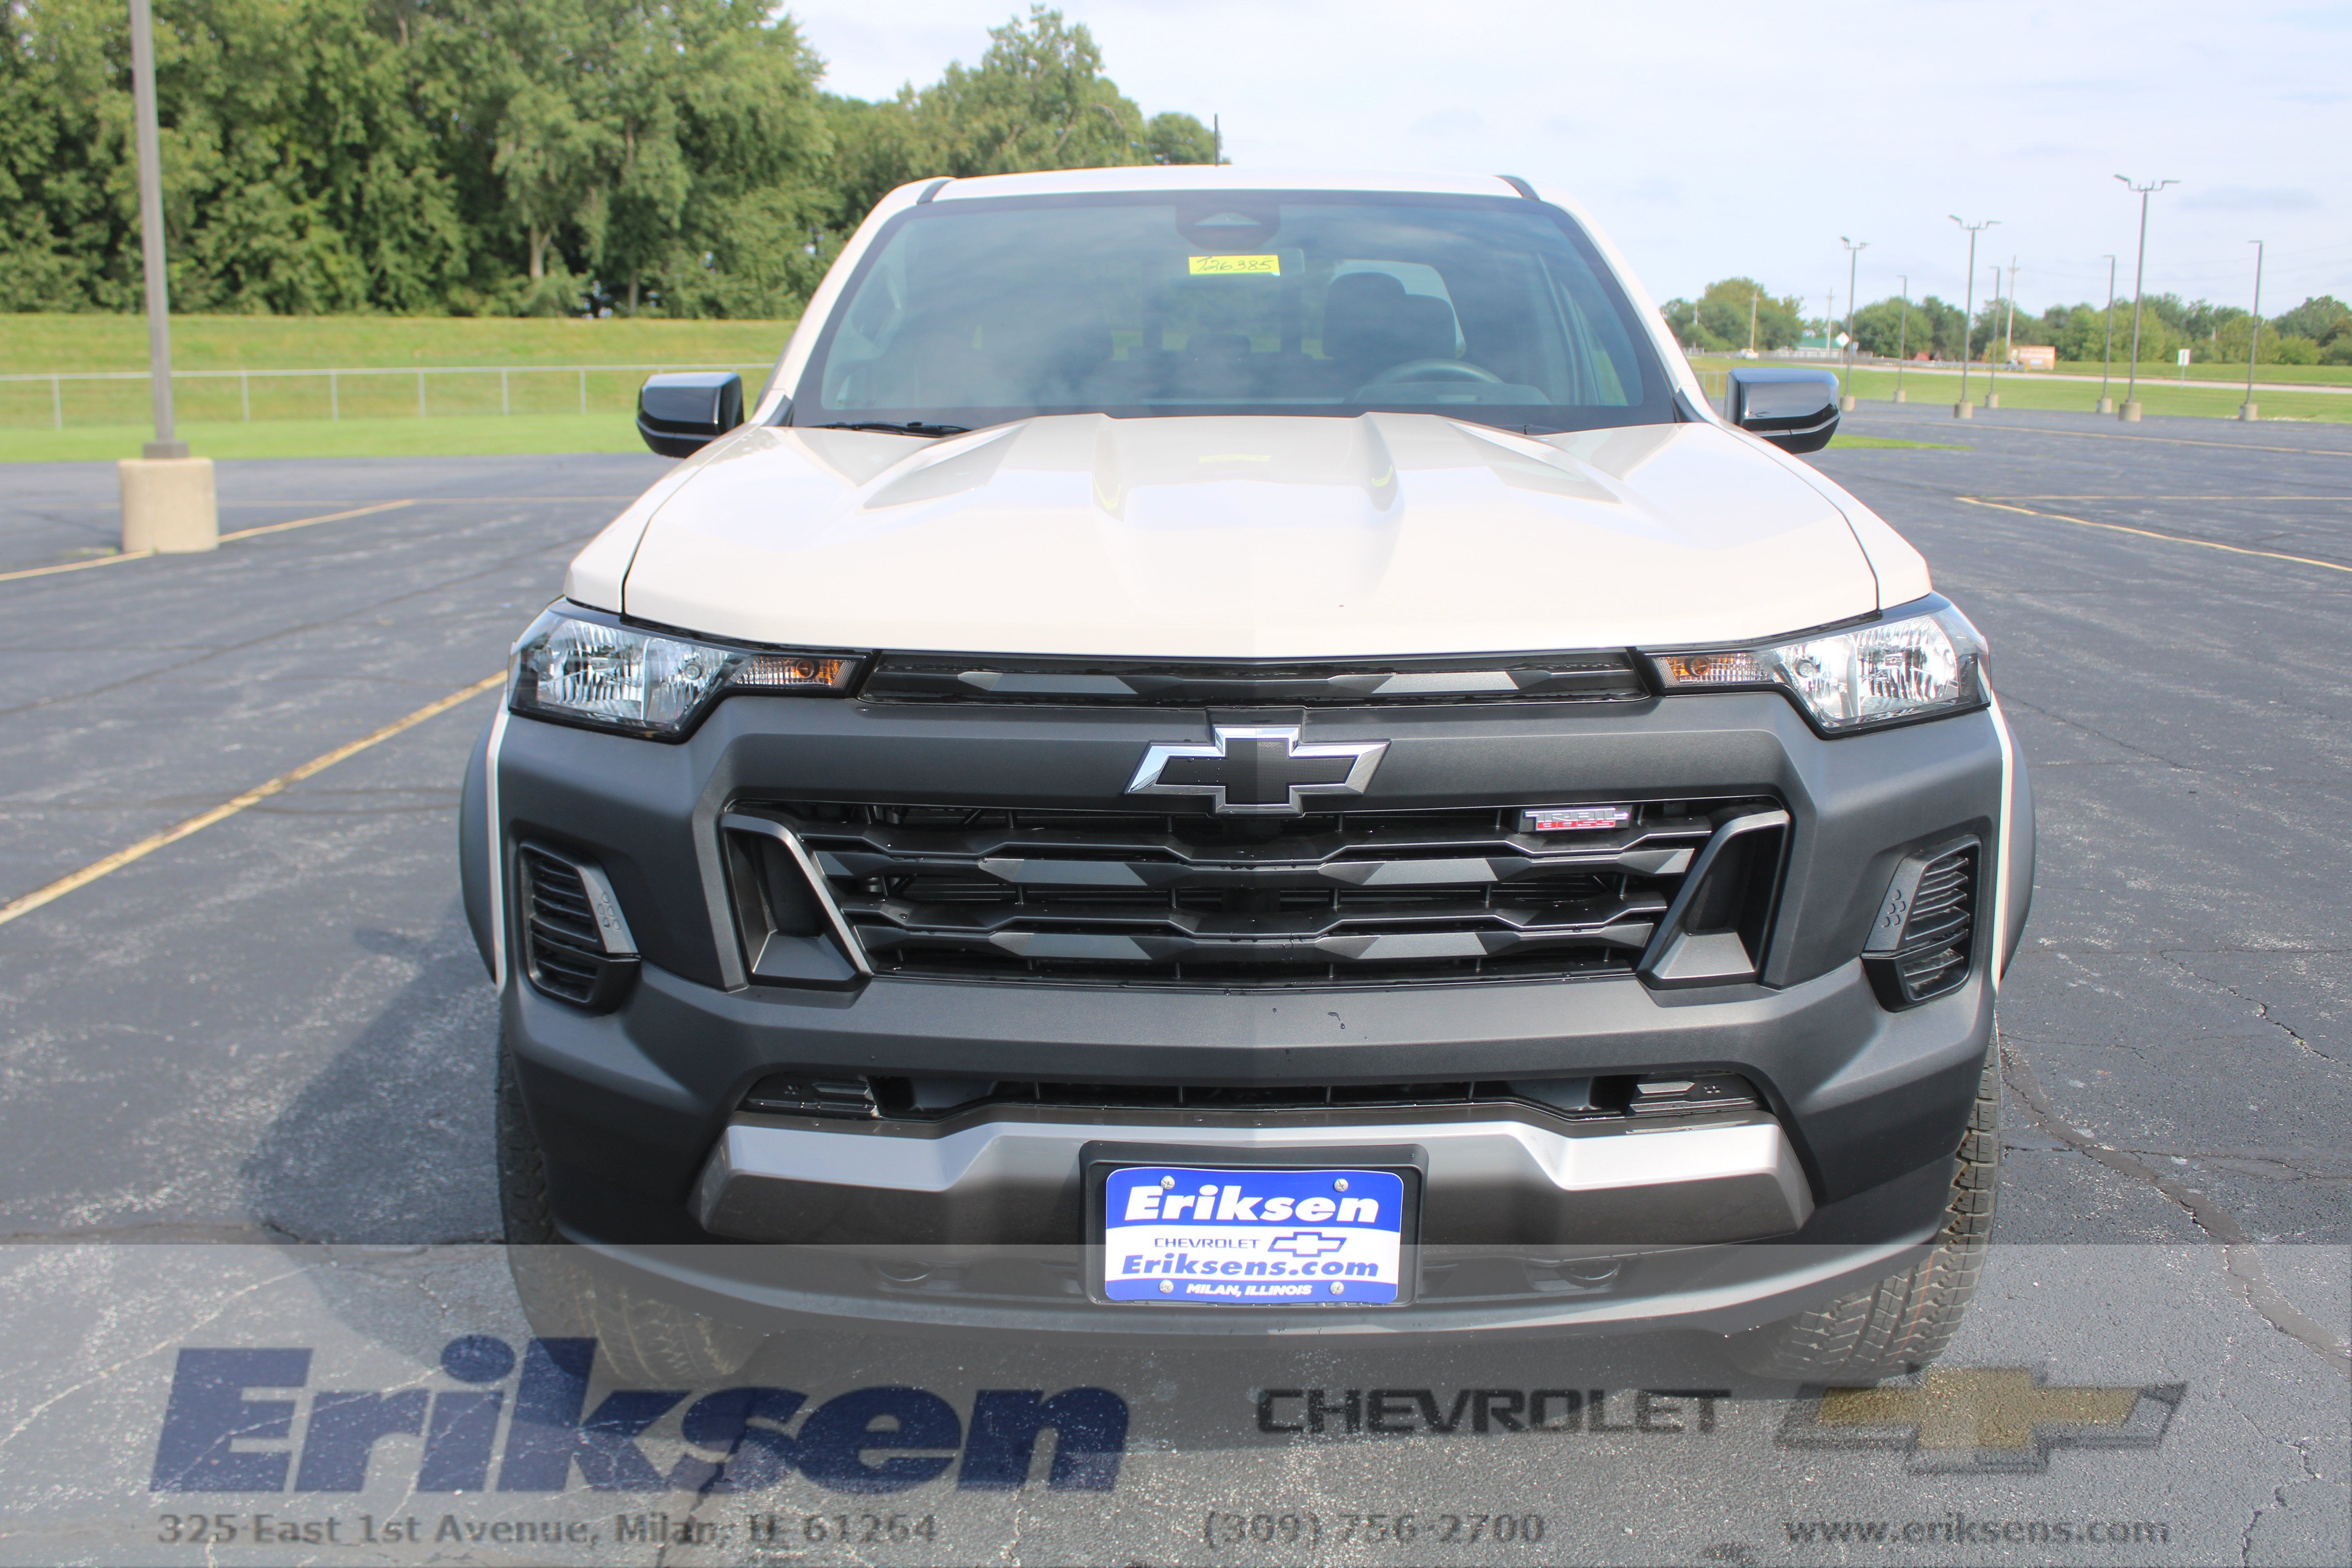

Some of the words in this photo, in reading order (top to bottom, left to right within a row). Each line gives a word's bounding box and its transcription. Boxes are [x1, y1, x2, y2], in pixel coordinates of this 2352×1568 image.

[1525, 807, 1628, 822] TRAIL
[1536, 820, 1615, 831] BOSS
[1125, 1185, 1379, 1223] Eriksen
[1154, 1238, 1260, 1249] CHEVROLET
[1122, 1253, 1379, 1277] Eriksens.com
[1186, 1283, 1242, 1296] MILAN,
[1245, 1284, 1312, 1296] ILLINOIS
